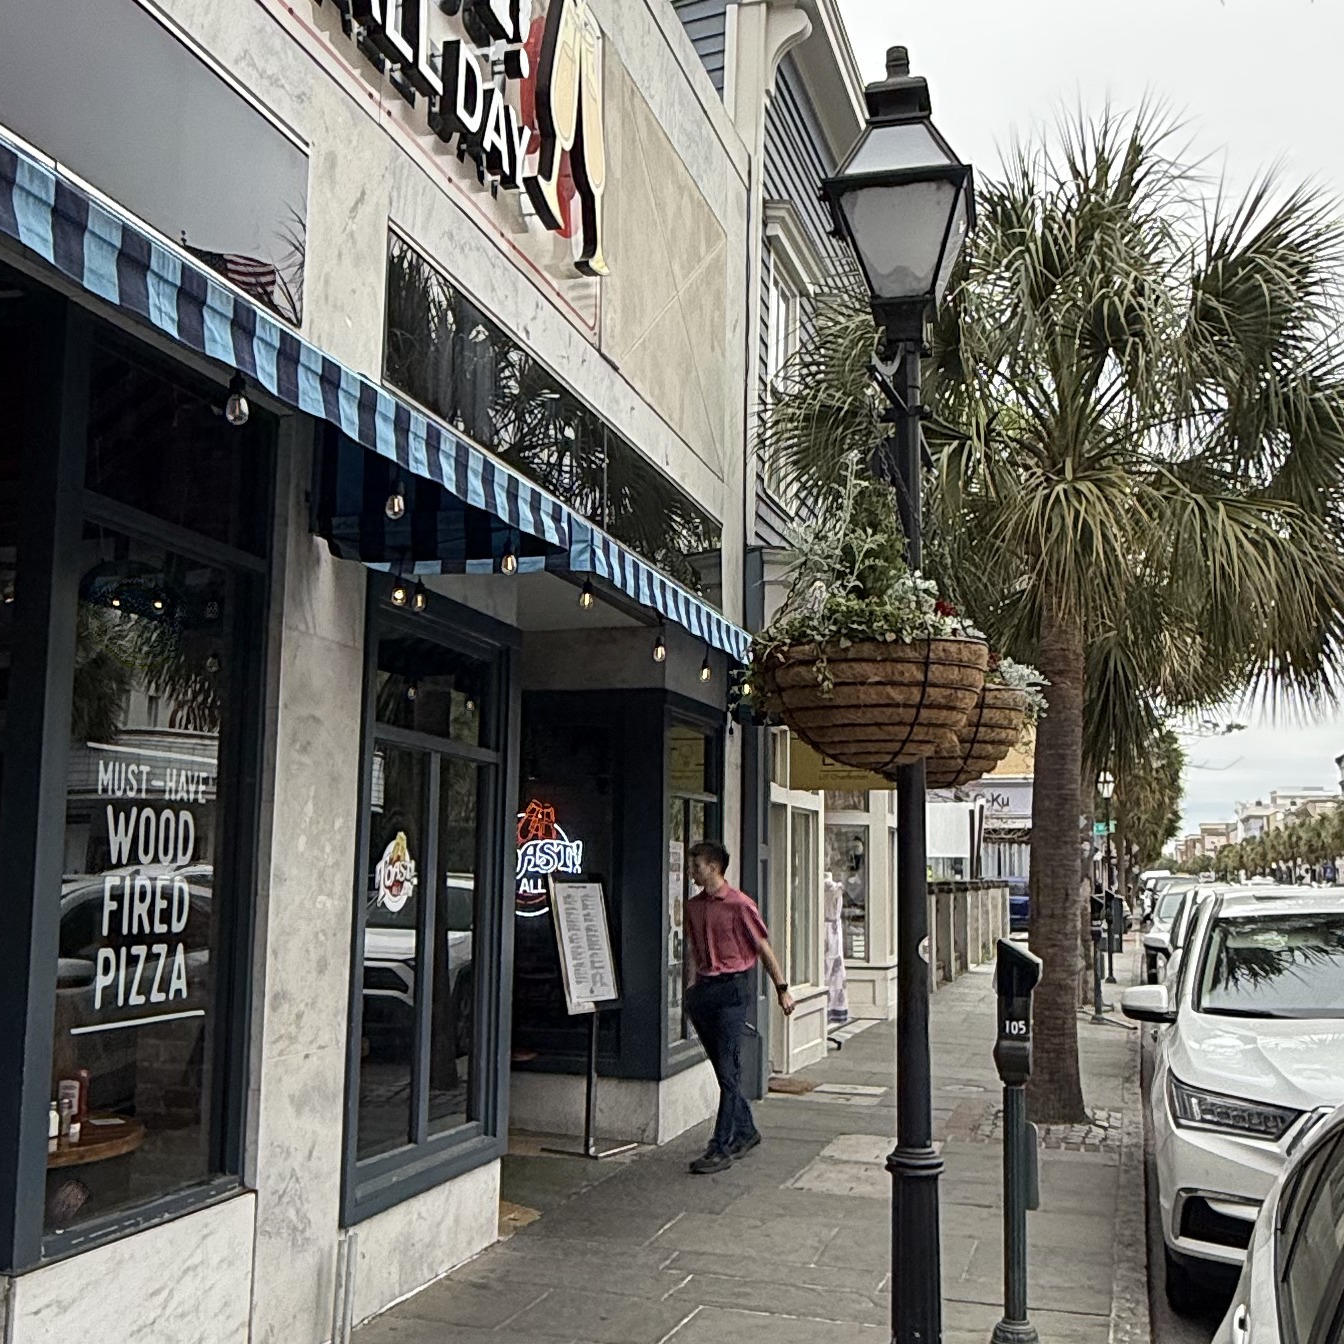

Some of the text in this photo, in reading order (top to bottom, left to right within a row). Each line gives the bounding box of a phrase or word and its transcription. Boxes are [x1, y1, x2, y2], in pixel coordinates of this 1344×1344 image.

[456, 38, 533, 193] DAY
[98, 760, 208, 804] MUST-HAVE
[106, 804, 196, 866] WOOD
[102, 875, 191, 937] FIRED
[520, 878, 546, 894] ALL
[94, 942, 188, 1010] PIZZA
[1005, 1020, 1027, 1035] 105
